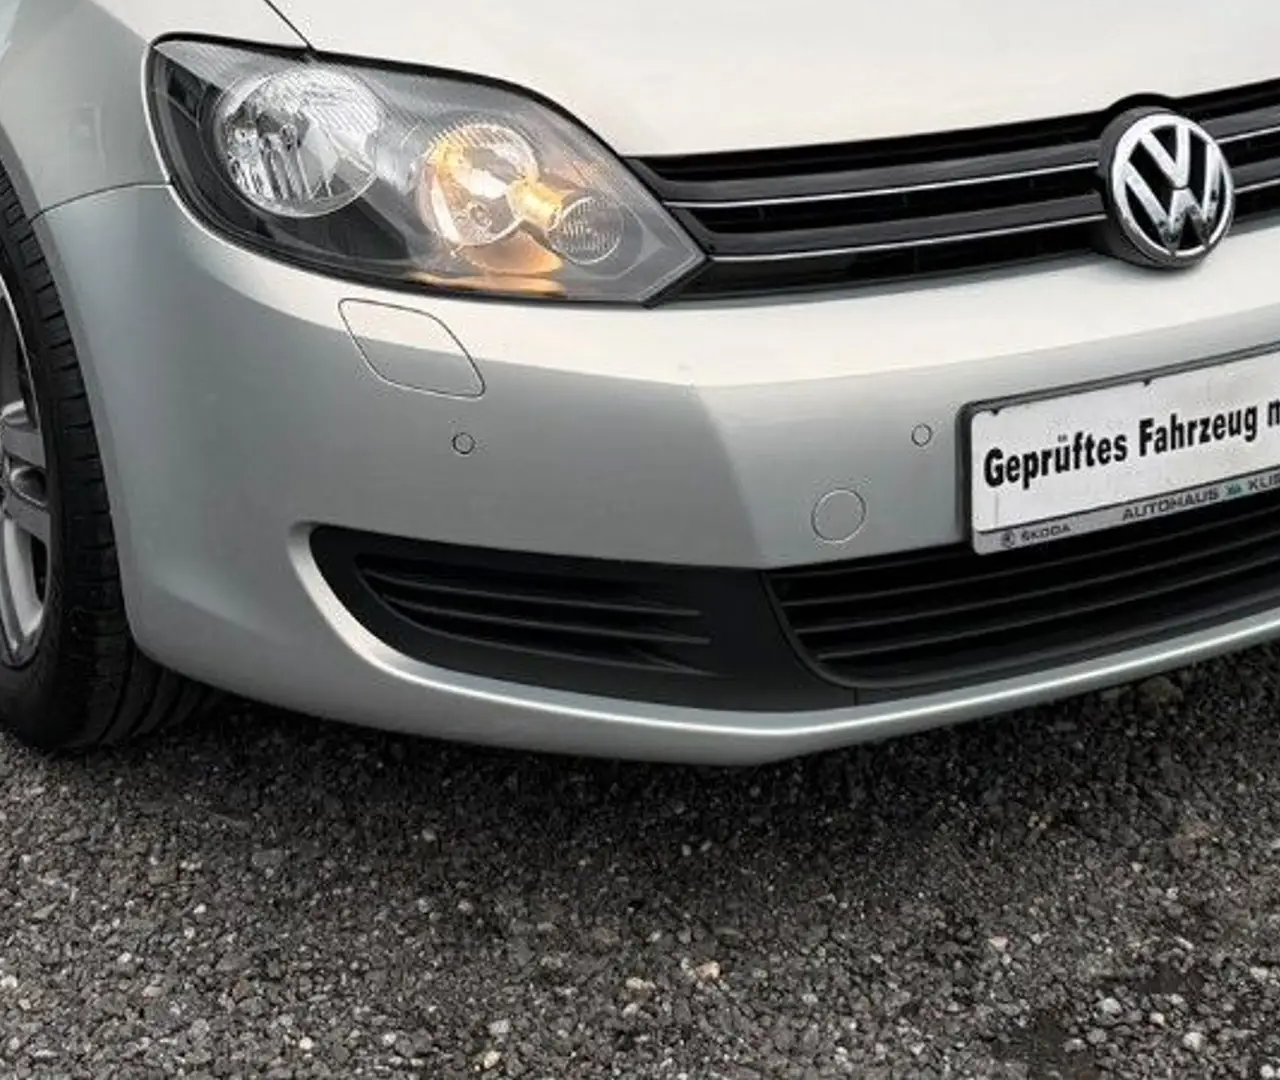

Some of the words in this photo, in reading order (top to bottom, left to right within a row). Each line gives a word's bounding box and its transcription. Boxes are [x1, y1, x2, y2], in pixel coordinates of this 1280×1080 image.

[983, 431, 1128, 490] Geprüftes
[1138, 406, 1258, 457] Fahrzeug
[1122, 486, 1221, 521] AUTOHAUS
